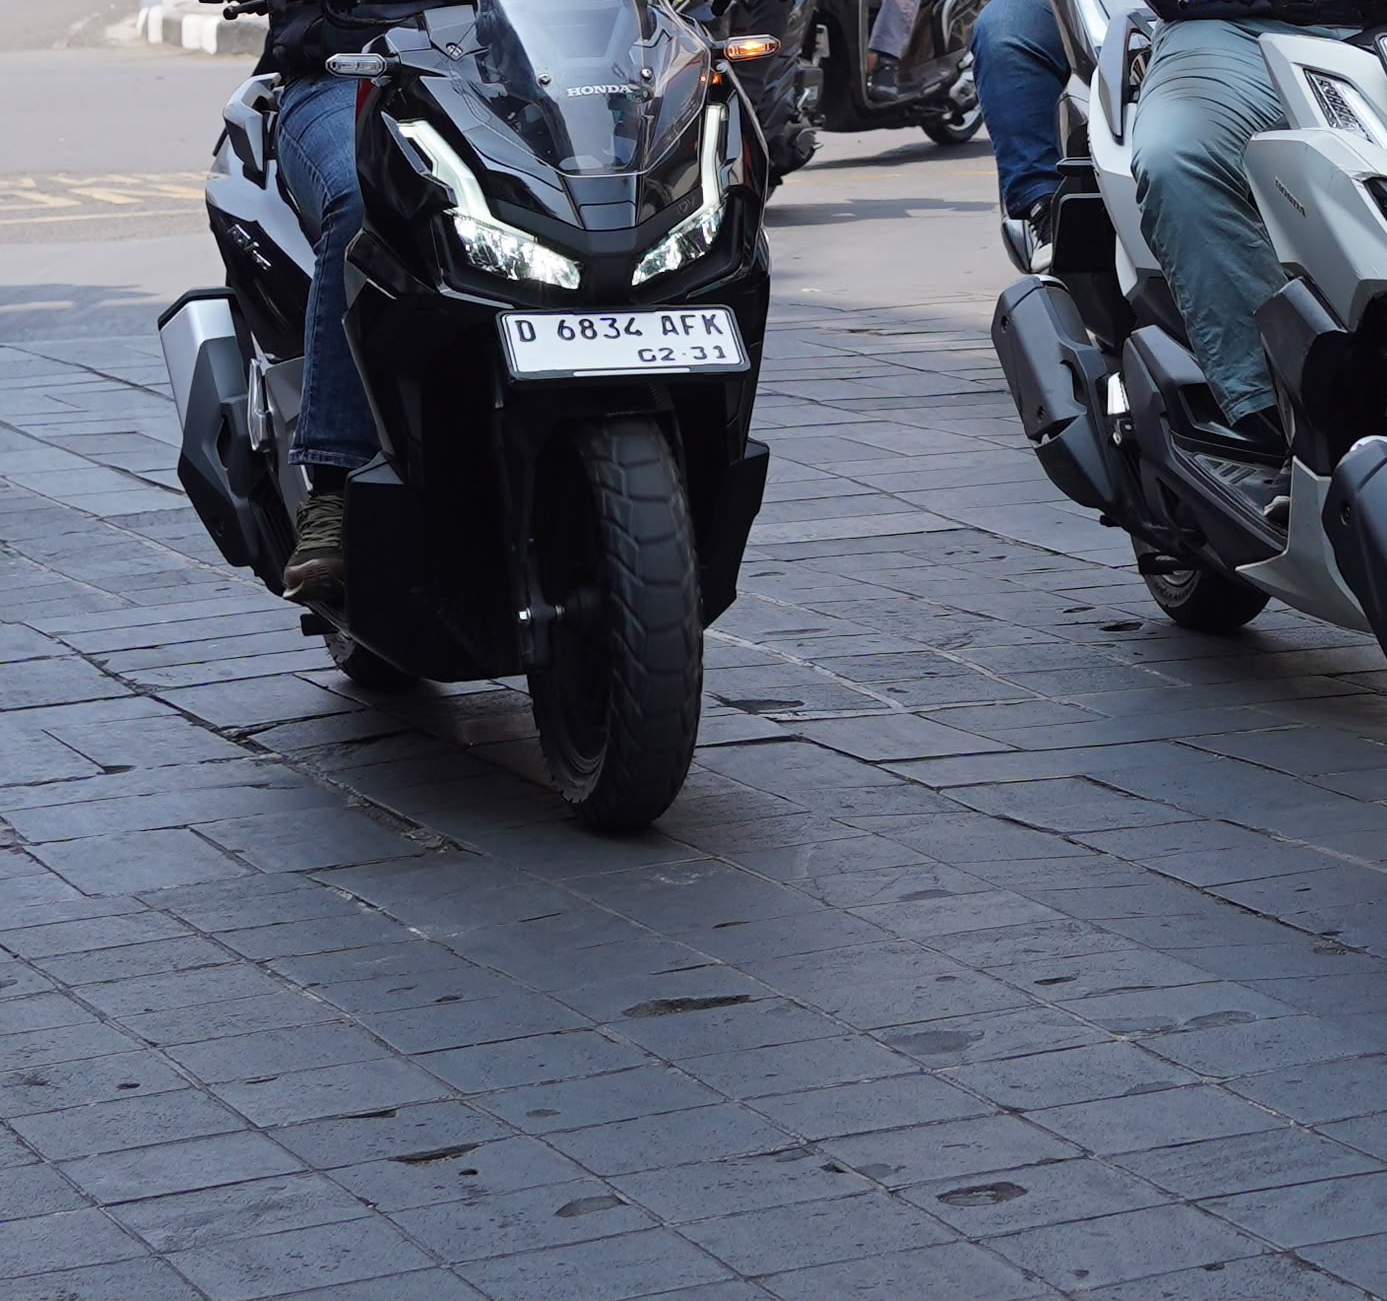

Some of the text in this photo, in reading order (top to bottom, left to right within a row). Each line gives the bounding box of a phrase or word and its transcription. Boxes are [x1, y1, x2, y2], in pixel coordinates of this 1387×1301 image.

[566, 84, 634, 97] HONDA
[514, 304, 724, 342] D 6834 AFK
